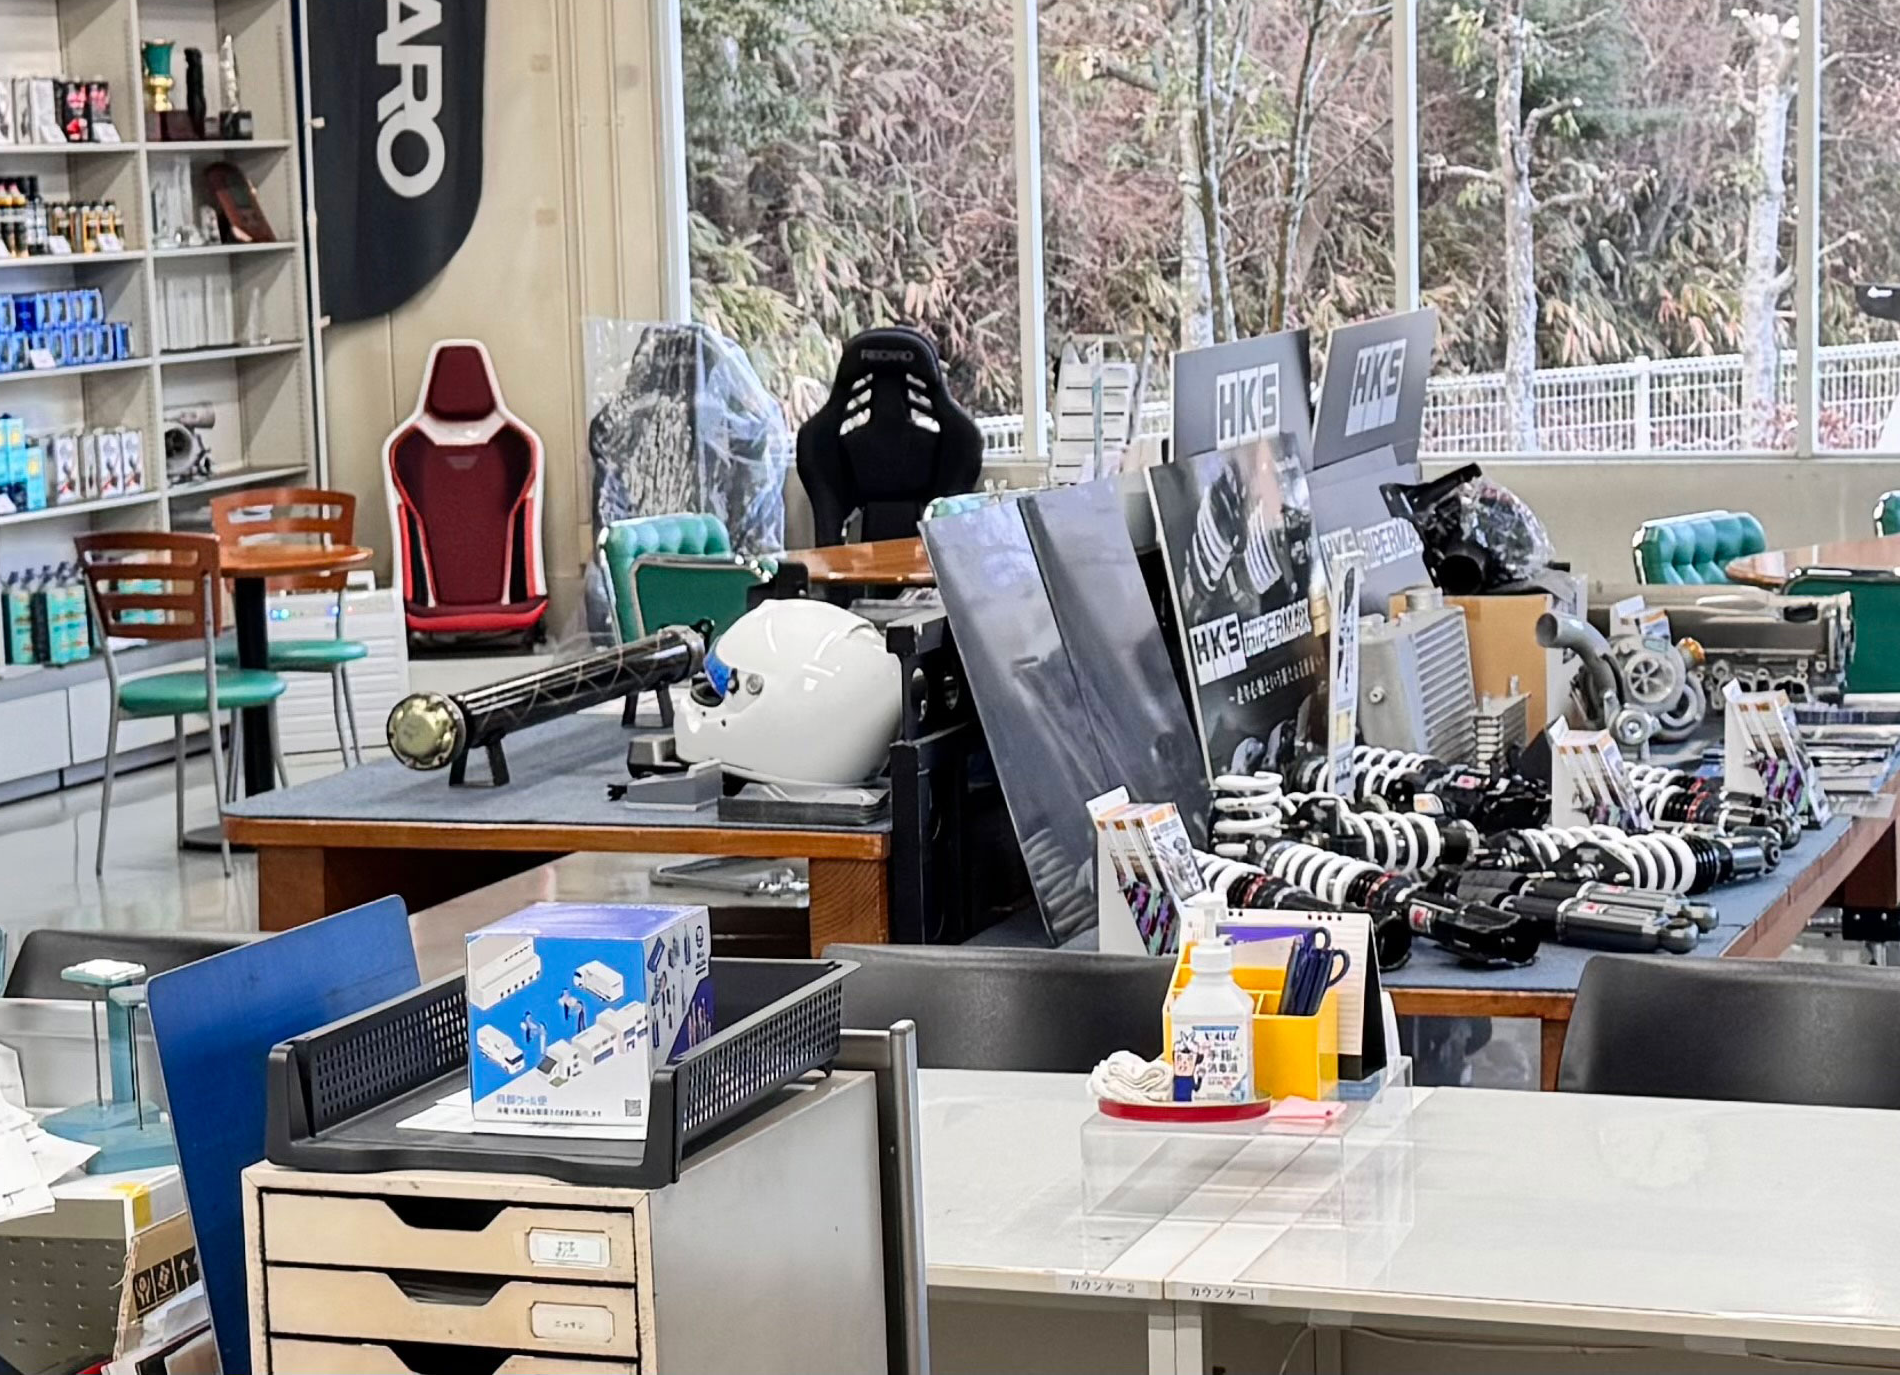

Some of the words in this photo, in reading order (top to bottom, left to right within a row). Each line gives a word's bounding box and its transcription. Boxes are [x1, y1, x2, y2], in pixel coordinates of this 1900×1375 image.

[1219, 371, 1278, 441] HKS
[1351, 346, 1403, 409] HKS
[1361, 519, 1424, 568] HIPERMA
[1192, 619, 1241, 668] HKS
[1243, 599, 1312, 657] HIPERMAX
